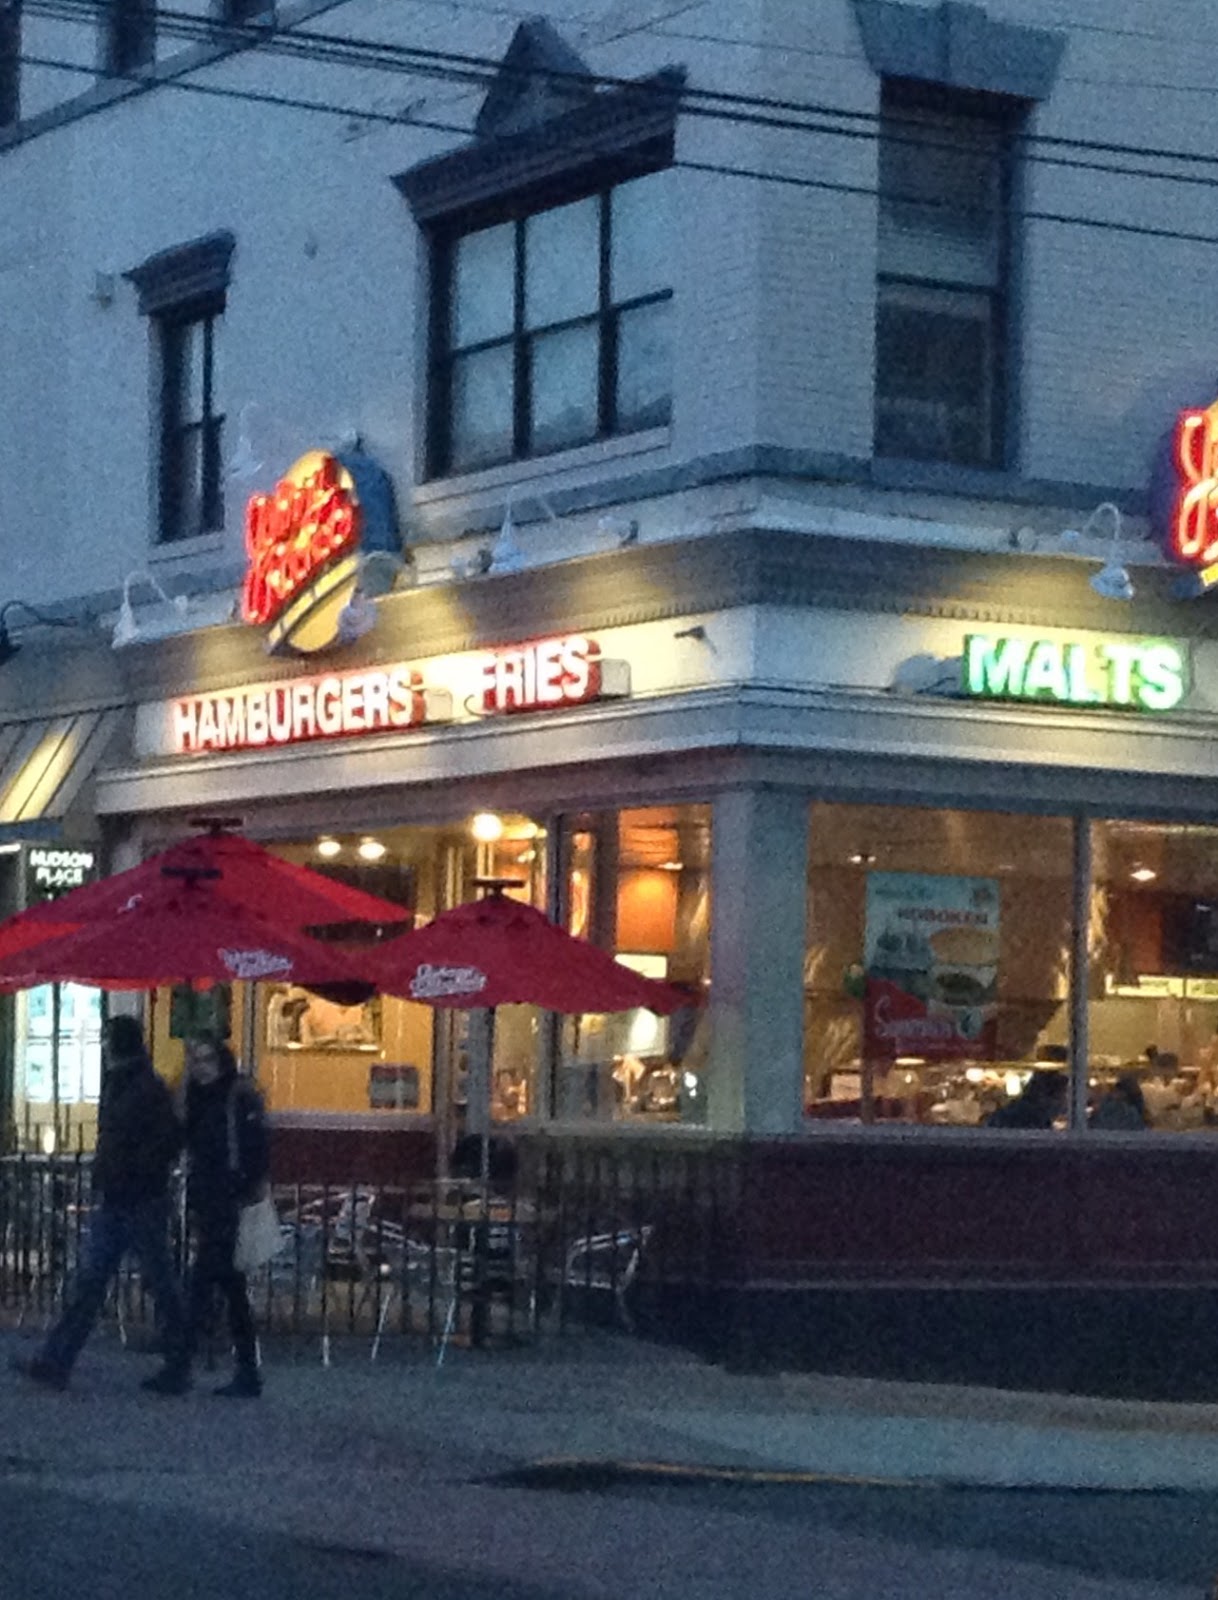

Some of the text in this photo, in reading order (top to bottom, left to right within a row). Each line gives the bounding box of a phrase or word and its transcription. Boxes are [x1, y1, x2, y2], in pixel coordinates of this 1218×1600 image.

[172, 635, 593, 752] HAMBURGERS FRIES
[965, 634, 1183, 710] MALTS
[30, 849, 93, 869] HUDSON
[36, 867, 83, 887] PLACE
